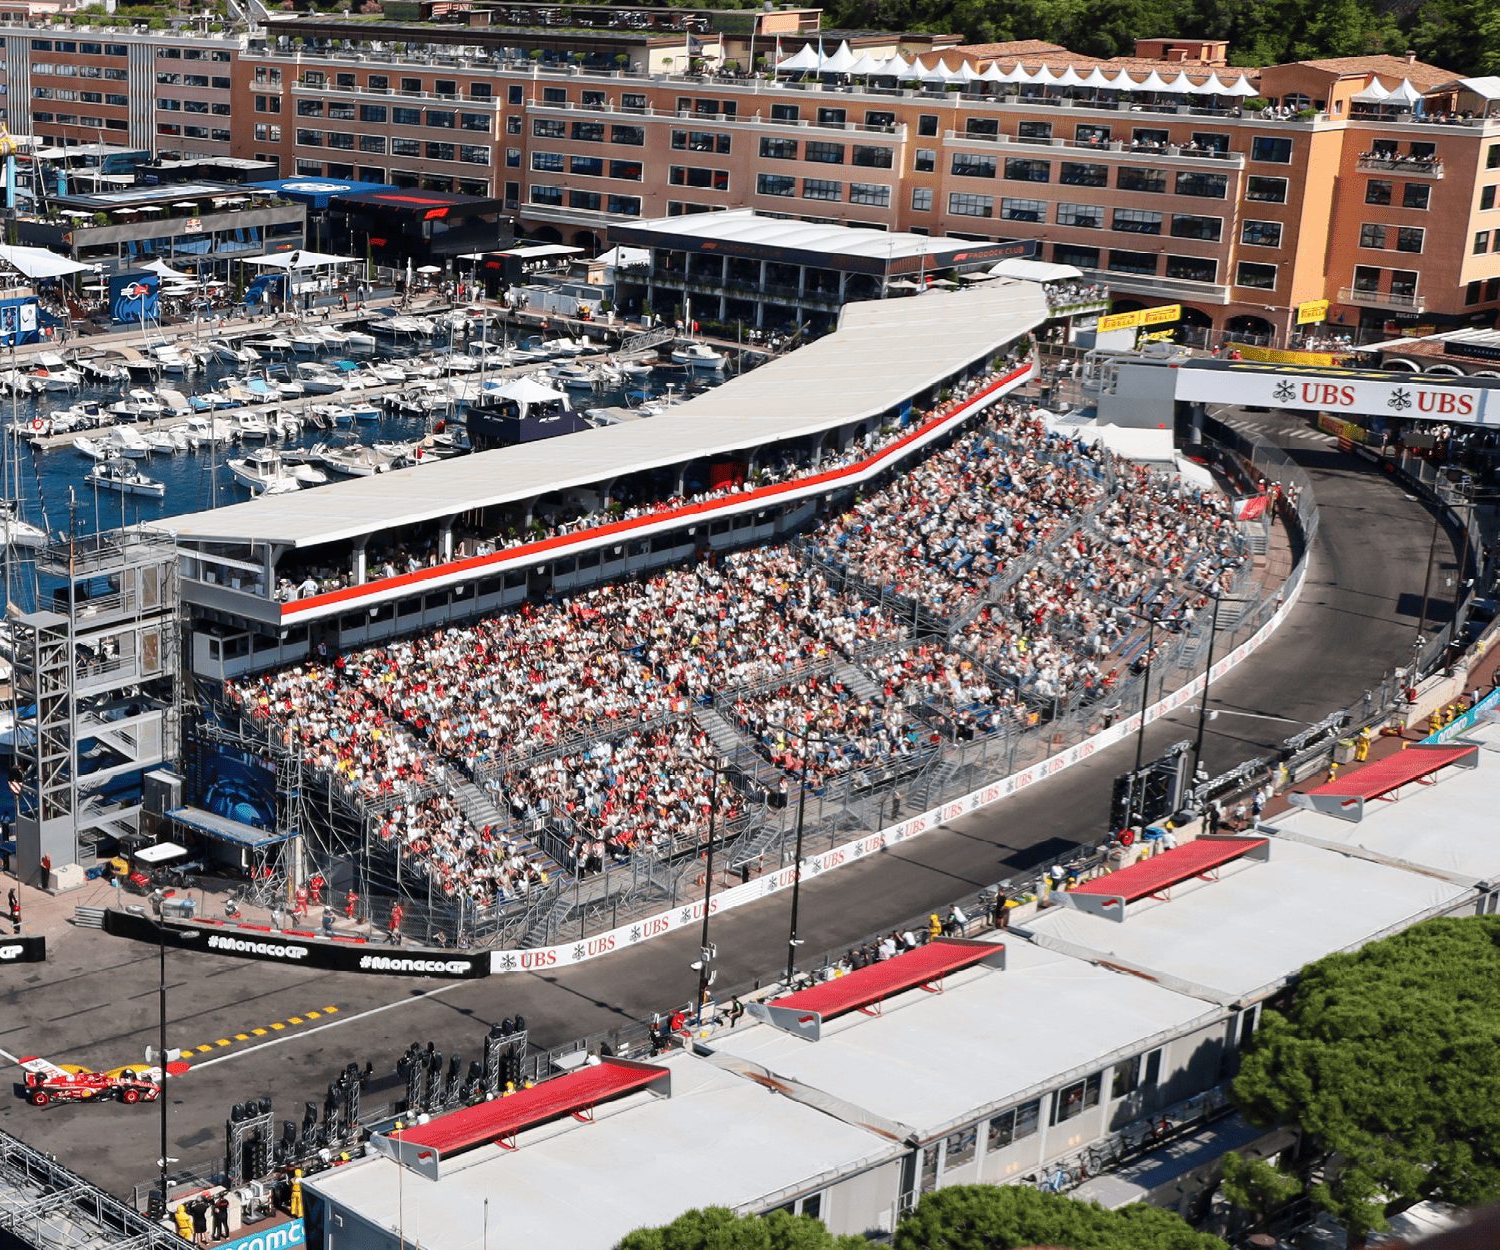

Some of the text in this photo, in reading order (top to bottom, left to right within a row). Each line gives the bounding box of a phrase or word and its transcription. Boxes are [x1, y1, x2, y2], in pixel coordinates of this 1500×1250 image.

[969, 248, 1003, 259] PADDOCK
[1005, 246, 1025, 255] CLUB
[1301, 382, 1355, 406] UBS
[1416, 390, 1473, 415] UBS
[1015, 771, 1033, 789] UBS
[981, 785, 999, 804] UBS
[943, 801, 963, 820] UBS
[905, 818, 926, 837] UBS
[865, 834, 886, 852] UBS
[823, 850, 845, 869] UBS
[643, 916, 669, 937] UBS
[587, 935, 615, 956] UBS
[520, 950, 557, 968] UBS
